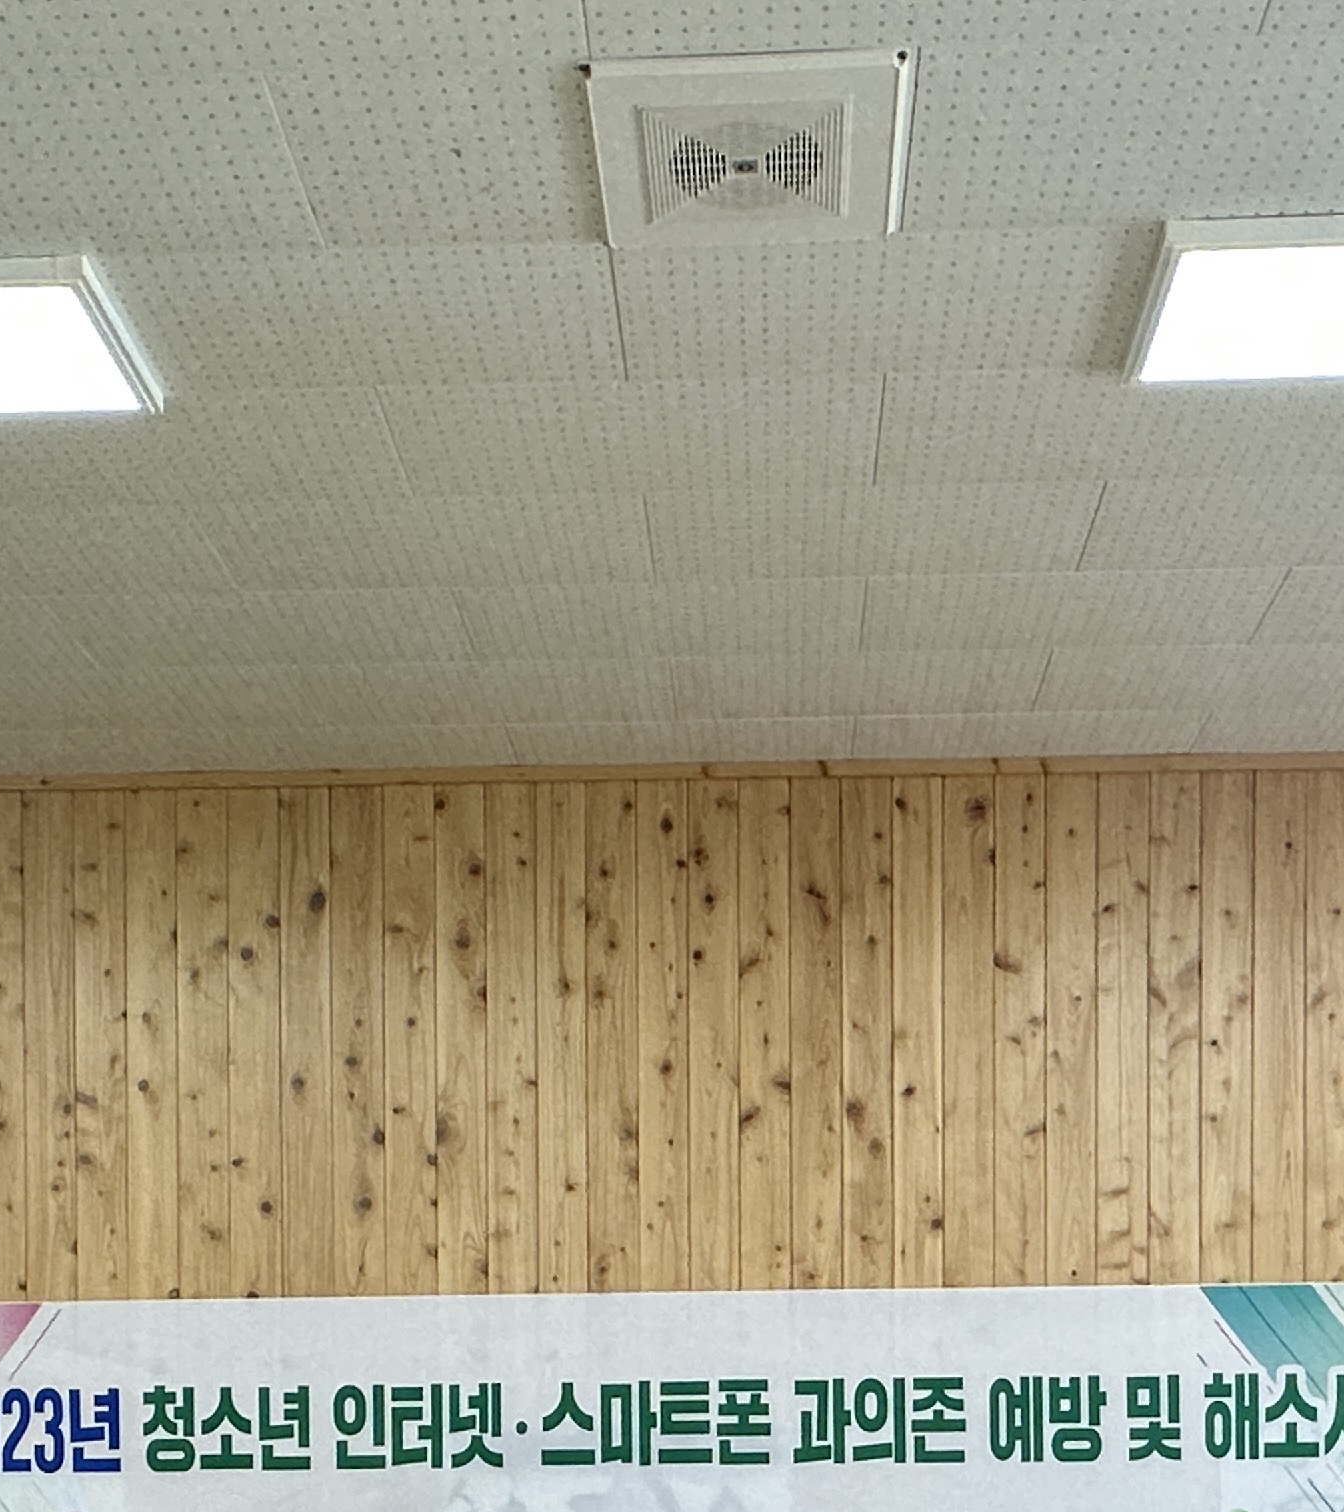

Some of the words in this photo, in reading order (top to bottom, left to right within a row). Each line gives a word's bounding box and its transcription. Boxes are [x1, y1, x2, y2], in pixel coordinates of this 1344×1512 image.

[142, 1384, 312, 1472] 청소년
[792, 1376, 966, 1464] 과의존
[989, 1375, 1107, 1462] 예방
[1126, 1374, 1182, 1461] 및
